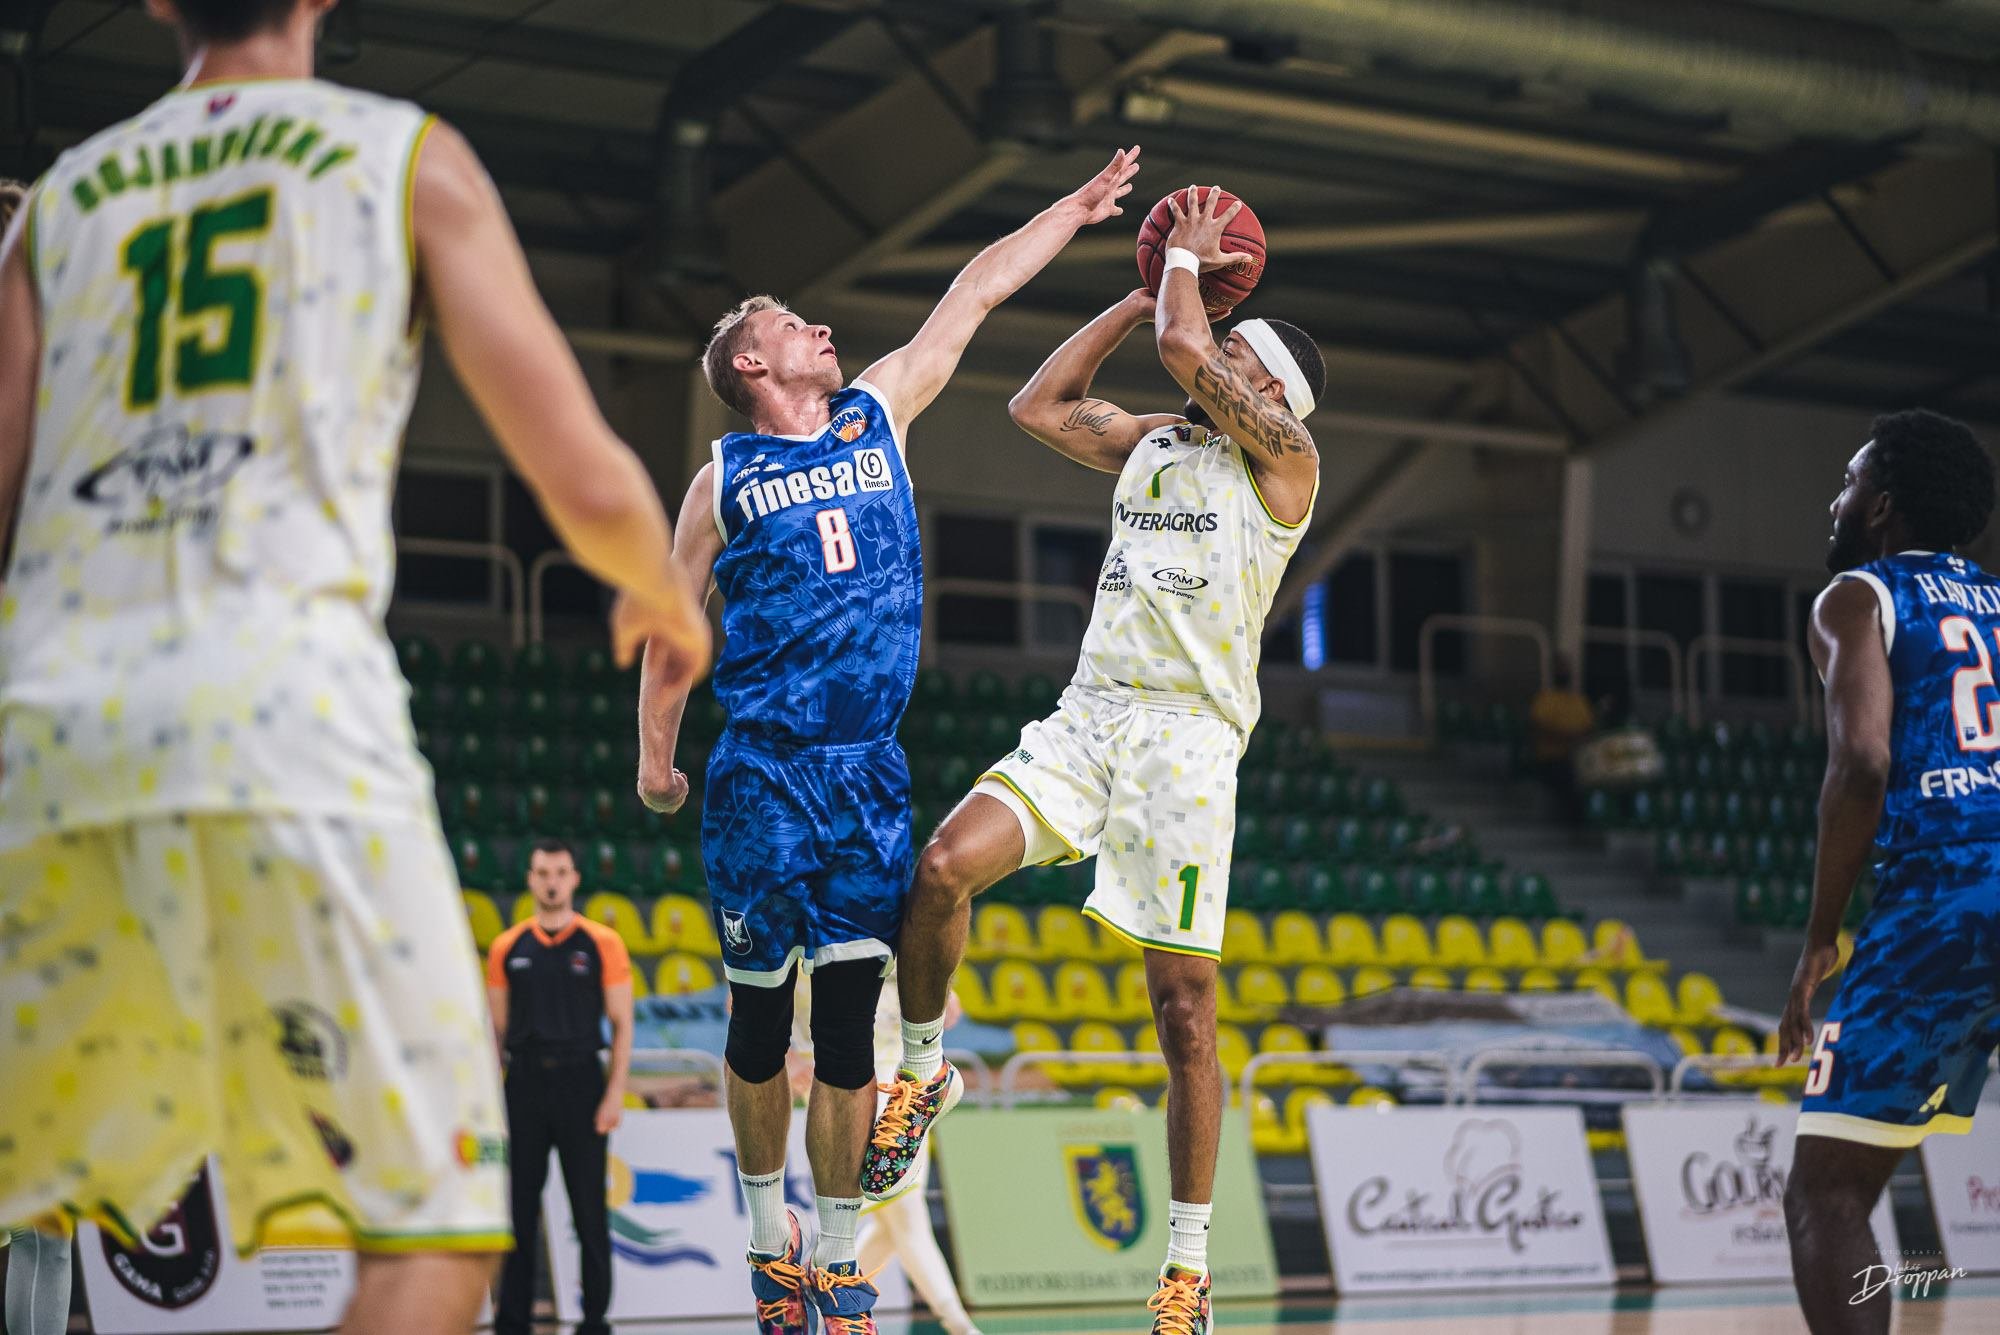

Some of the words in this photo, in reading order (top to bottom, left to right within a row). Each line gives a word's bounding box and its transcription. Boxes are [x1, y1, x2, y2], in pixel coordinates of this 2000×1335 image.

[118, 184, 276, 413] 15
[831, 411, 864, 434] BKM
[736, 460, 858, 524] finesa
[864, 479, 890, 488] finesa
[815, 507, 857, 574] 8
[1114, 501, 1218, 533] INTERAGROS
[1166, 571, 1194, 586] TAM
[1913, 573, 2000, 615] HAWKI
[1939, 615, 2000, 752] 2
[1178, 864, 1201, 931] 1
[1804, 1021, 1841, 1096] 5
